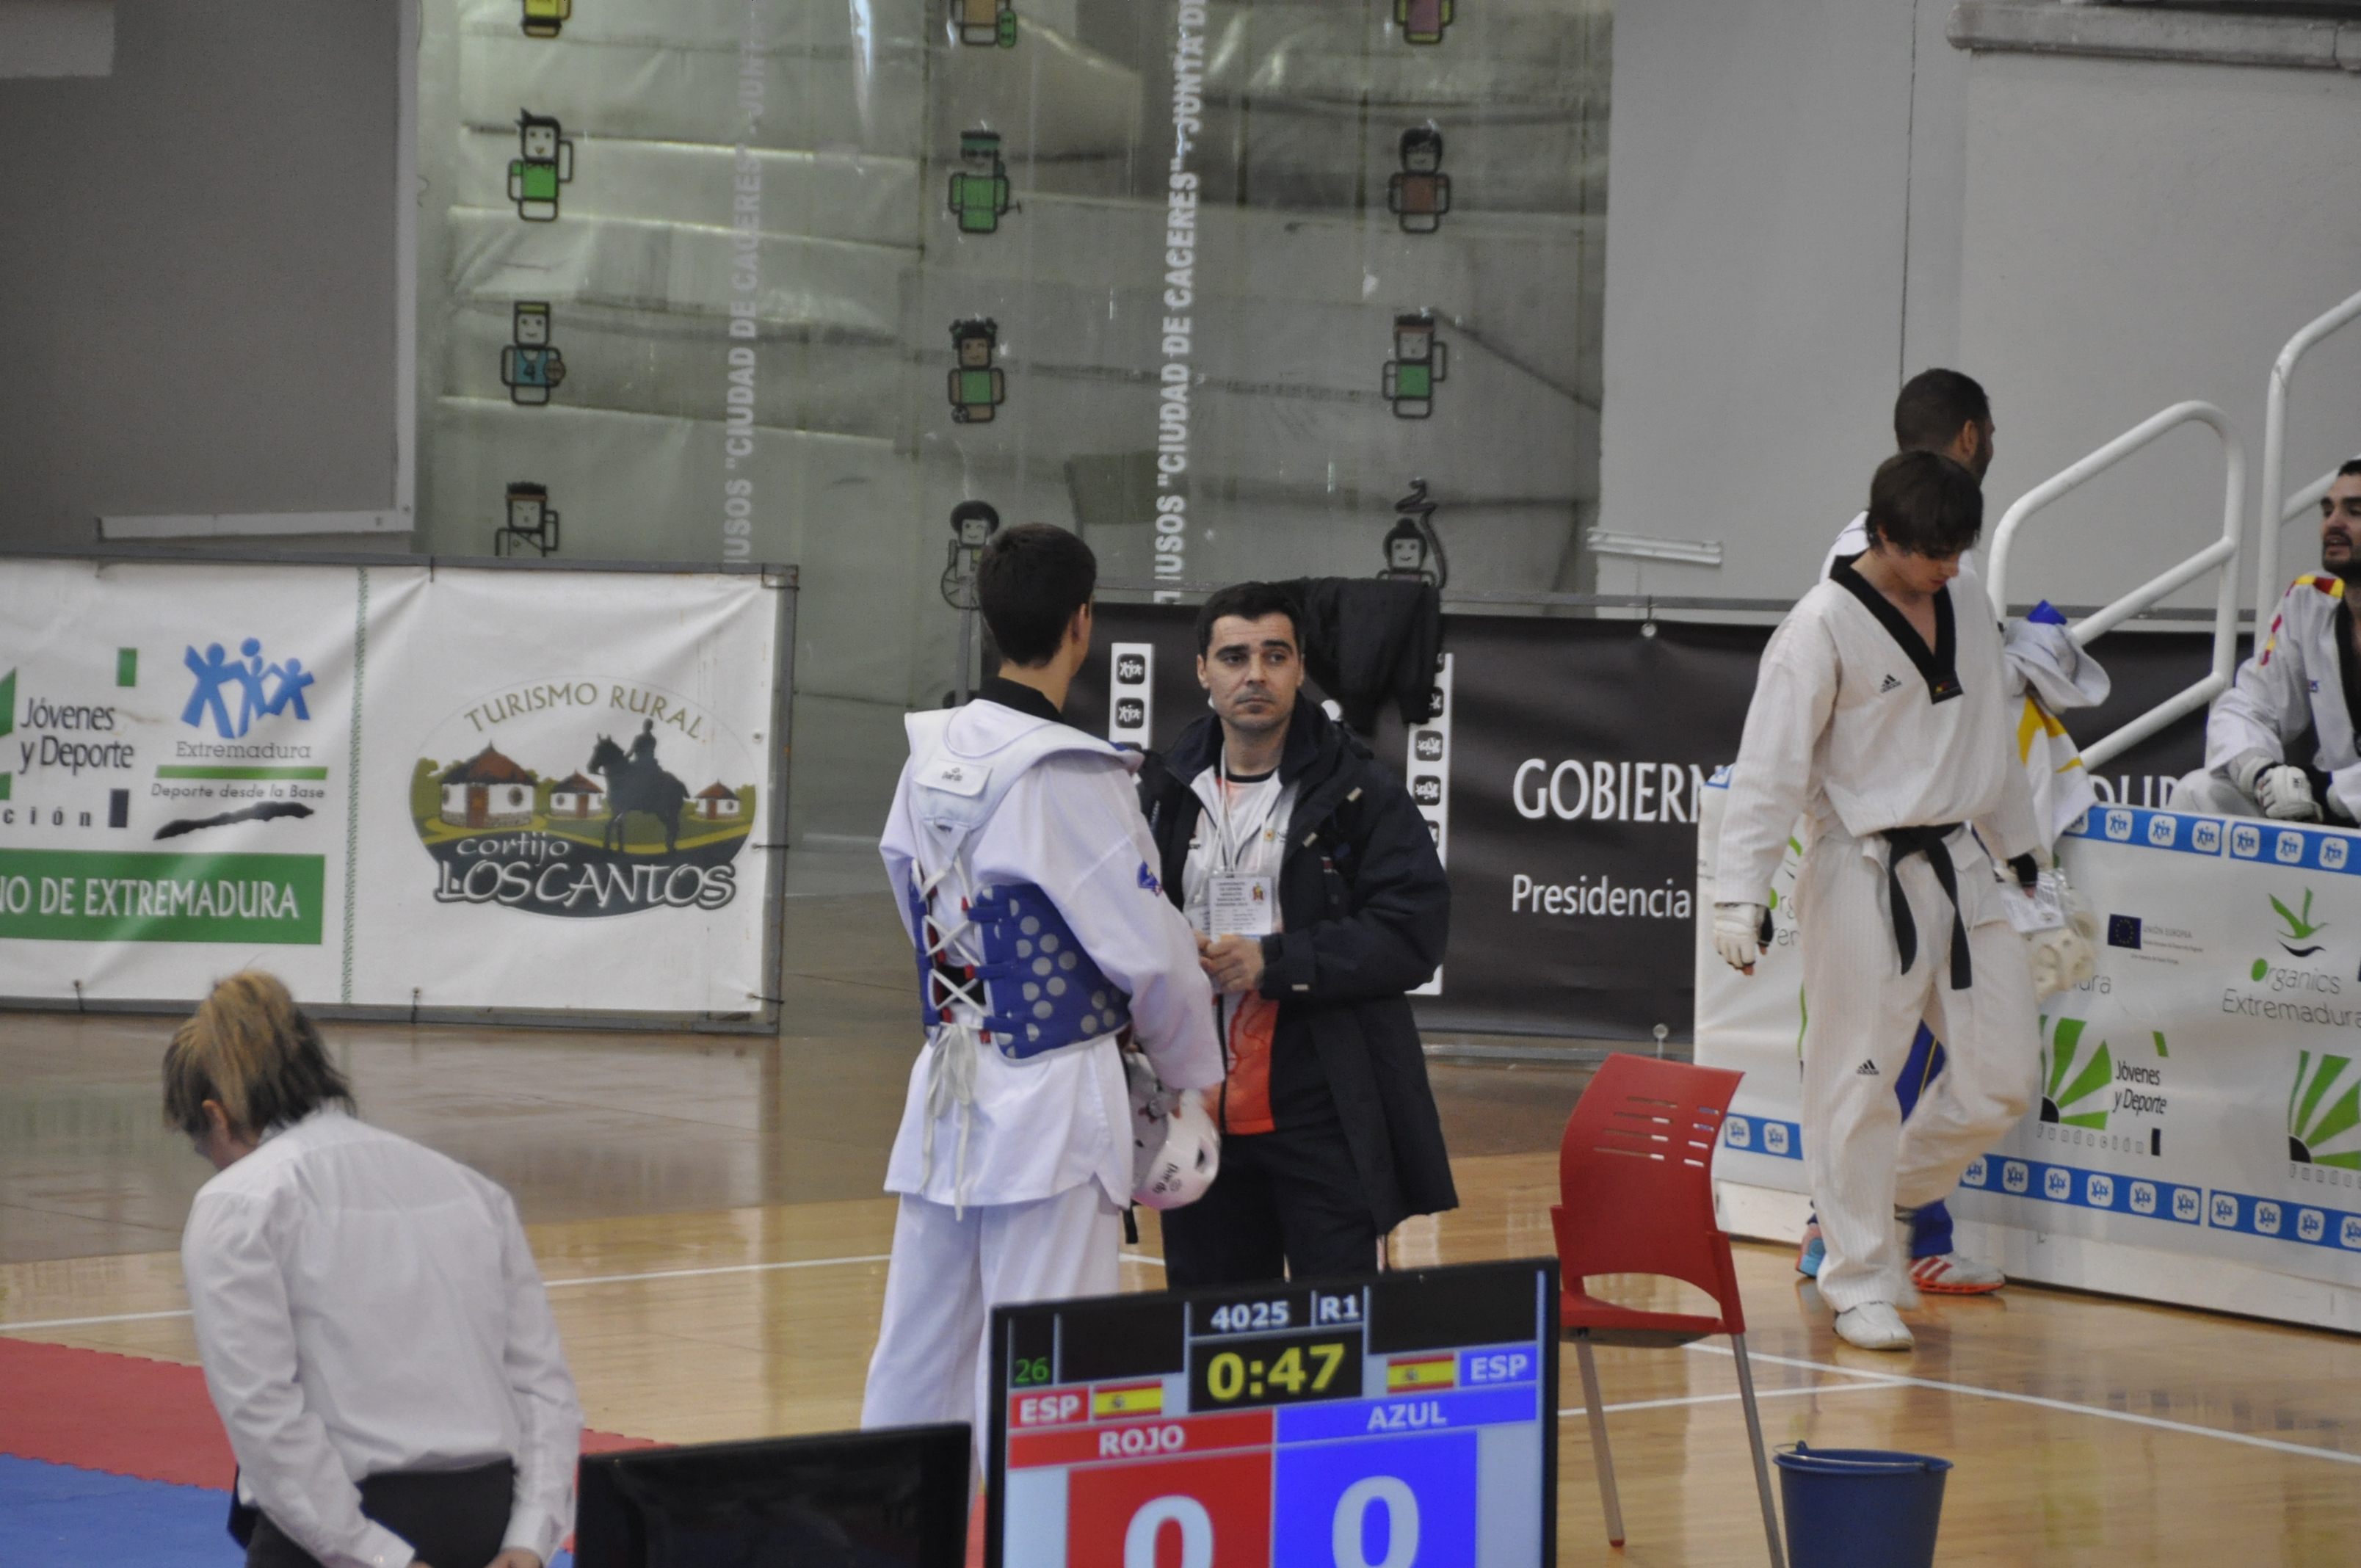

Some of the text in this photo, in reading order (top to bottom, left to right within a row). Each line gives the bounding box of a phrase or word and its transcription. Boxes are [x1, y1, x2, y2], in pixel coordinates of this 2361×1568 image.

[1172, 35, 1205, 134] JUNTA
[730, 301, 757, 338] DE
[1162, 316, 1191, 355] DE
[20, 697, 115, 731] Jóvenes
[464, 683, 705, 739] TURISMO RURAL
[18, 736, 134, 776] y Deporte
[176, 741, 311, 760] Extremadura
[151, 783, 325, 800] Deporte desde la Base
[457, 832, 570, 867] cortijo
[40, 876, 76, 915] DE
[84, 878, 300, 920] EXTREMADURA
[1512, 874, 1691, 918] Presidencia
[2116, 1060, 2161, 1086] Jóvenes
[2112, 1088, 2167, 1117] y Deporte
[1211, 1295, 1359, 1329] 4025 R1
[1015, 1343, 1345, 1401] 26 0:47
[1470, 1354, 1528, 1382] ESP
[1019, 1394, 1080, 1423] ESP
[1367, 1403, 1447, 1431] AZUL
[1099, 1425, 1185, 1458] ROJO
[1332, 1476, 1419, 1568] 0
